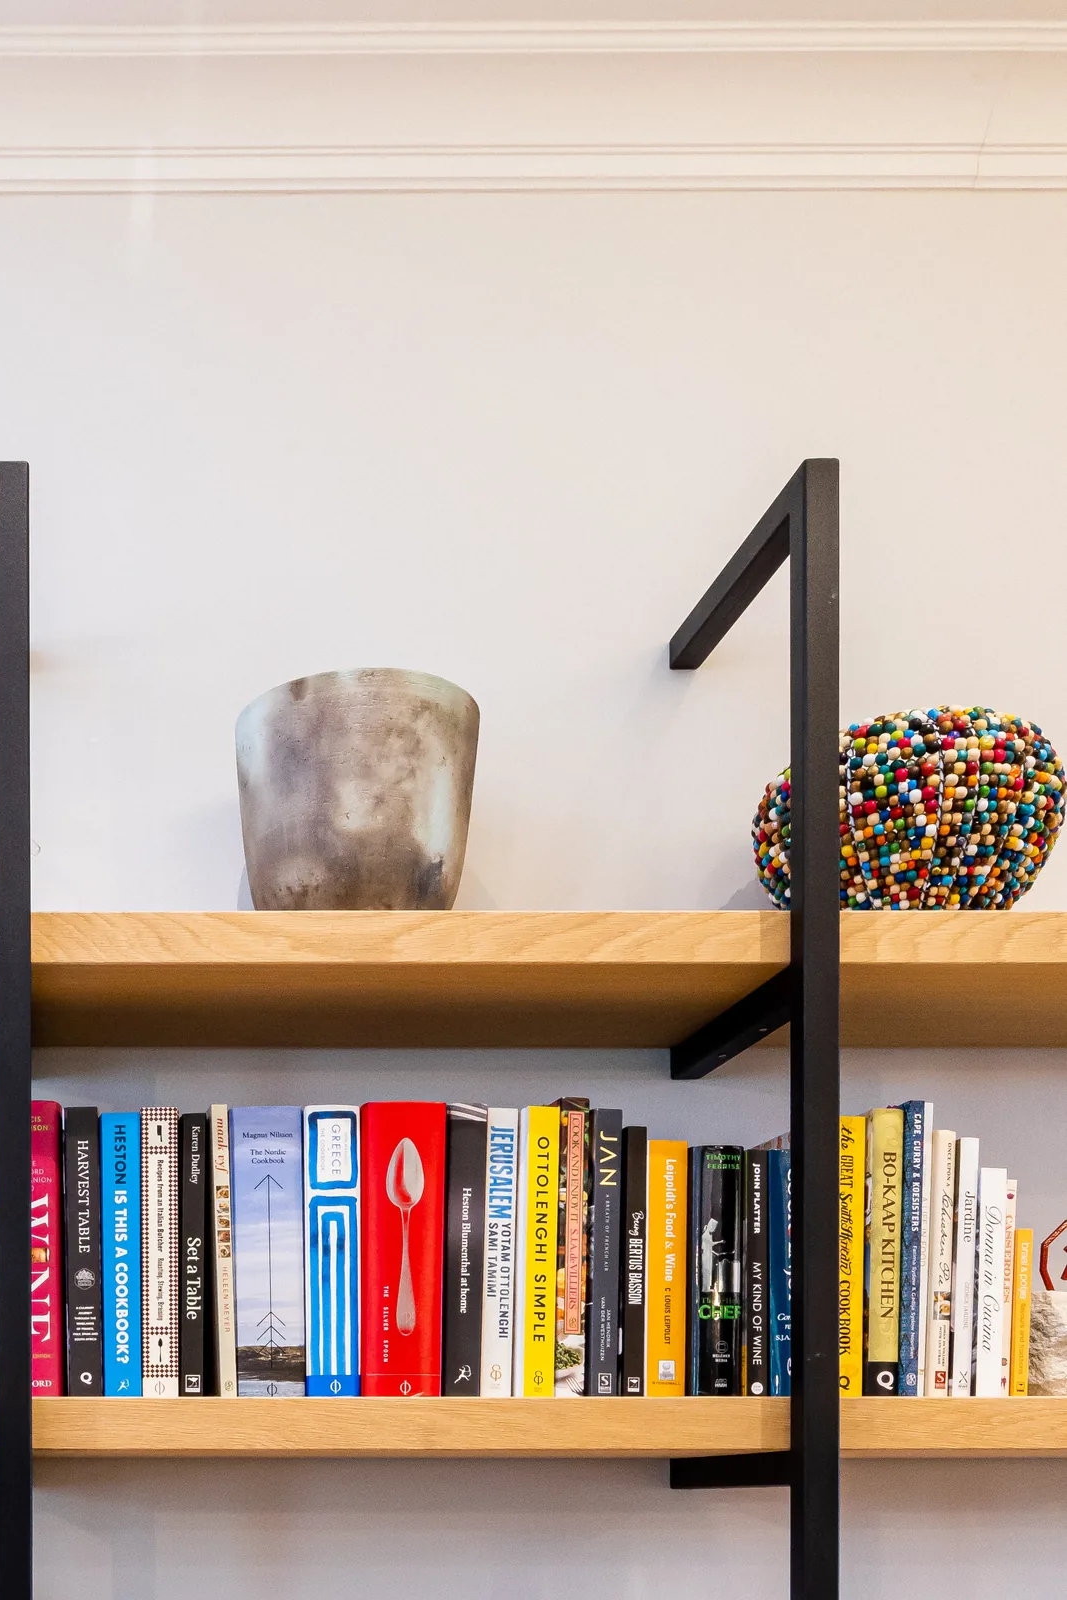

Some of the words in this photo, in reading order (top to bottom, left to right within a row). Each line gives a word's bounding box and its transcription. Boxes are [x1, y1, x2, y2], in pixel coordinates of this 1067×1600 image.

[191, 1126, 201, 1152] Karen
[242, 1132, 268, 1140] Magnus
[269, 1131, 294, 1139] Nilsson
[571, 1117, 581, 1152] COOK
[912, 1113, 922, 1137] CAPE,
[114, 1125, 127, 1185] HESTON
[331, 1123, 341, 1175] GREECE
[912, 1140, 922, 1169] CURRY
[77, 1140, 90, 1206] HARVEST
[156, 1159, 164, 1179] Recipes
[189, 1154, 201, 1185] Dudley
[488, 1126, 515, 1219] JERUSALEM
[571, 1152, 581, 1177] AND
[752, 1163, 761, 1189] JOHN
[114, 1190, 128, 1203] IS
[156, 1184, 164, 1198] from
[535, 1136, 550, 1262] OTTOLENGHI
[570, 1178, 580, 1212] ENJOY
[663, 1158, 677, 1210] Leipoldt's
[882, 1151, 897, 1233] BO-KAAP
[156, 1199, 164, 1207] an
[156, 1207, 164, 1228] Italian
[461, 1187, 472, 1220] Heston
[753, 1191, 761, 1234] PLATTER
[911, 1181, 920, 1232] KOESISTERS
[963, 1190, 976, 1243] Jardine
[78, 1209, 91, 1253] TABLE
[114, 1208, 128, 1242] THIS
[570, 1213, 580, 1224] IT
[604, 1225, 610, 1234] OF
[628, 1210, 645, 1236] Being
[665, 1212, 677, 1238] Food
[156, 1229, 164, 1252] Butcher
[186, 1237, 202, 1261] Set
[460, 1221, 472, 1276] Blumenthal
[488, 1222, 499, 1251] SAMI
[500, 1222, 511, 1262] YOTAM
[664, 1241, 674, 1250] &
[984, 1205, 1003, 1268] Donna
[114, 1246, 128, 1258] A
[628, 1238, 643, 1270] BERTUS
[1003, 1214, 1014, 1304] CASSEROLES
[186, 1265, 198, 1274] a
[460, 1277, 469, 1287] at
[486, 1256, 498, 1298] TAMIMI
[664, 1253, 676, 1282] Wine
[752, 1262, 762, 1280] MY
[880, 1238, 896, 1319] KITCHEN
[983, 1269, 997, 1289] in
[186, 1277, 202, 1320] Table
[459, 1288, 470, 1314] home
[498, 1266, 510, 1338] OTTOLENGHI
[628, 1272, 642, 1305] BASSON
[752, 1283, 762, 1312] KIND
[114, 1262, 129, 1364] COOKBOOK?
[533, 1274, 547, 1342] SIMPLE
[698, 1304, 742, 1320] CHEF
[752, 1315, 762, 1332] OF
[982, 1294, 1001, 1354] Cucina
[752, 1335, 762, 1366] WINE
[80, 1371, 93, 1385] Q
